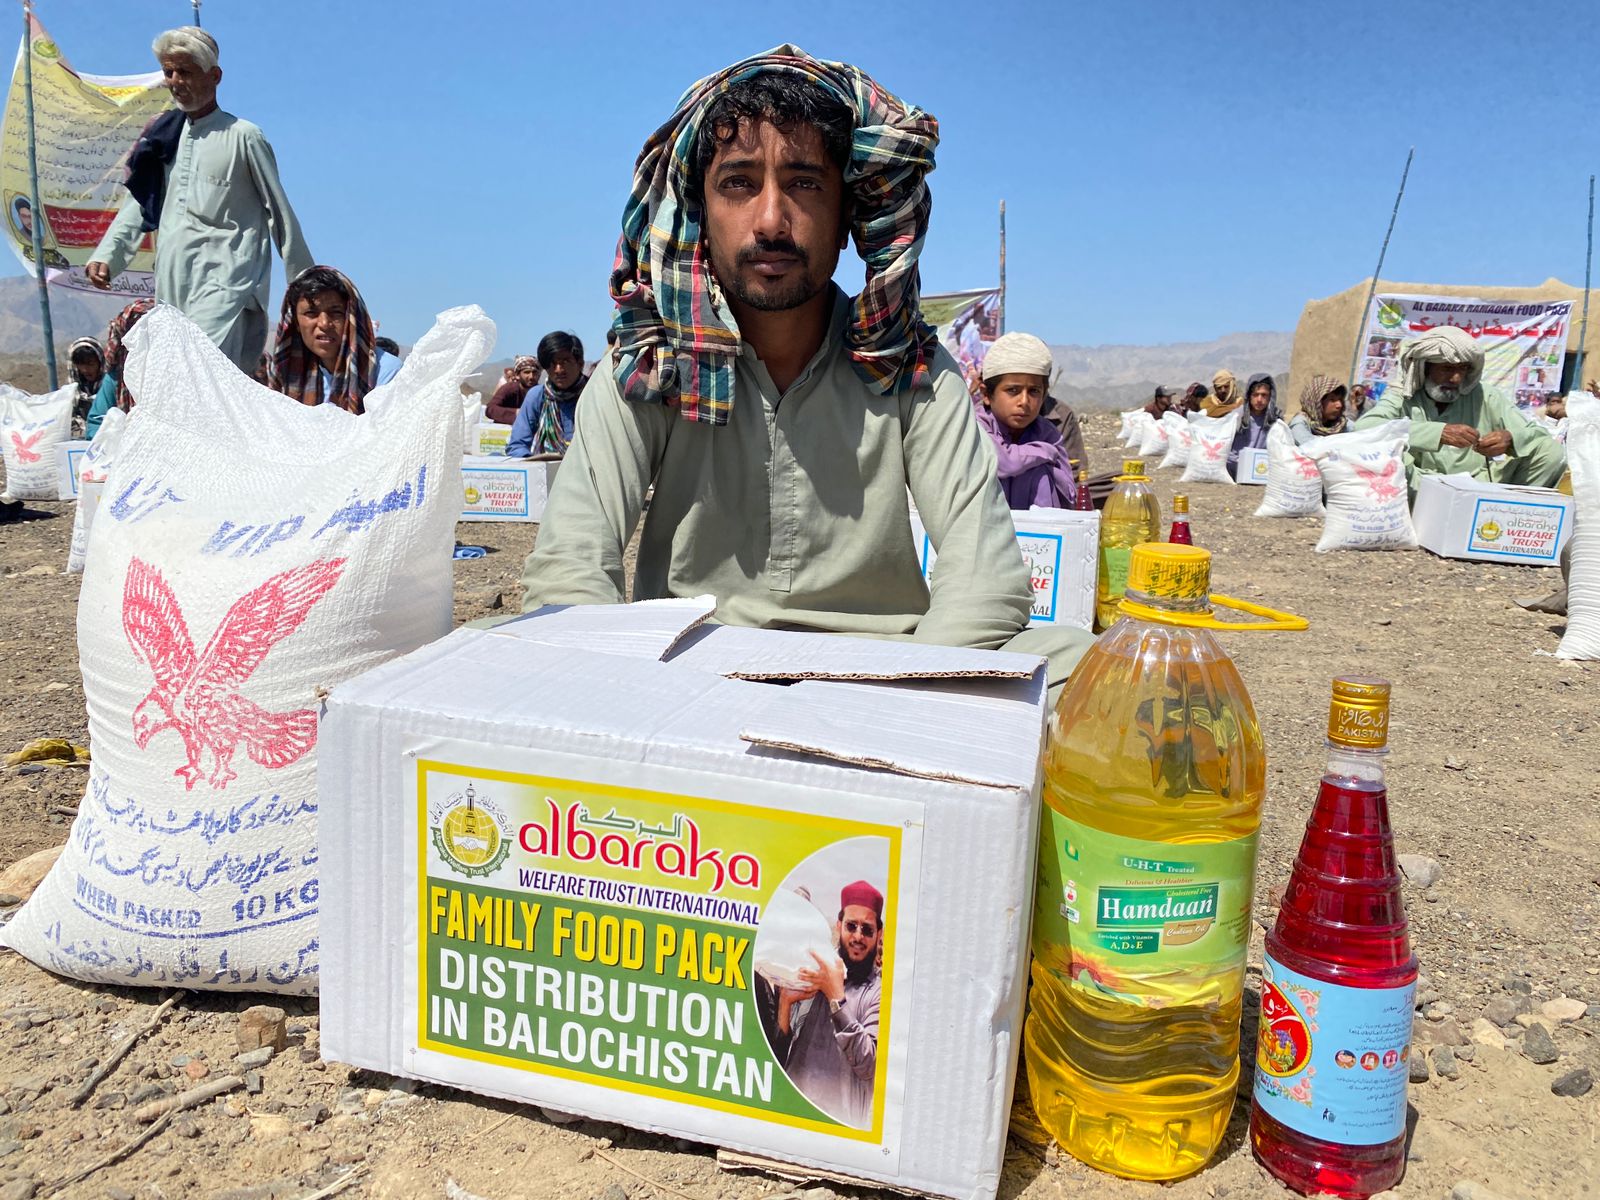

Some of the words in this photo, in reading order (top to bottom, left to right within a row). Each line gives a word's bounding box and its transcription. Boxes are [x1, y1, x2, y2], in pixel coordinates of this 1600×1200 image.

[1412, 301, 1424, 311] AL
[1466, 303, 1515, 314] RAMADAN
[1516, 305, 1546, 316] FOOD
[484, 492, 524, 500] WELFARE
[202, 515, 306, 558] VIP
[1507, 529, 1556, 540] WELFARE
[1512, 538, 1547, 548] TRUST
[1501, 545, 1553, 556] INTERNATIONAL
[1338, 725, 1384, 738] PAKISTAN
[518, 798, 760, 892] albaraka
[447, 856, 469, 874] Welfare
[1123, 857, 1163, 872] U-H-T
[1166, 866, 1195, 874] Treated
[76, 873, 117, 917] WHEN
[122, 899, 201, 928] PACKED
[232, 894, 266, 922] 10
[519, 868, 585, 897] WELFARE
[588, 879, 636, 904] TRUST
[637, 887, 760, 926] INTERNATIONAL
[1166, 889, 1199, 897] Cholesterol
[1102, 897, 1213, 920] Hamdaan
[431, 885, 541, 952] FAMILY
[553, 906, 645, 971] FOOD
[655, 923, 750, 990] PACK
[440, 947, 744, 1045] DISTRIBUTION
[431, 994, 468, 1041] IN
[483, 1005, 773, 1103] BALOCHISTAN
